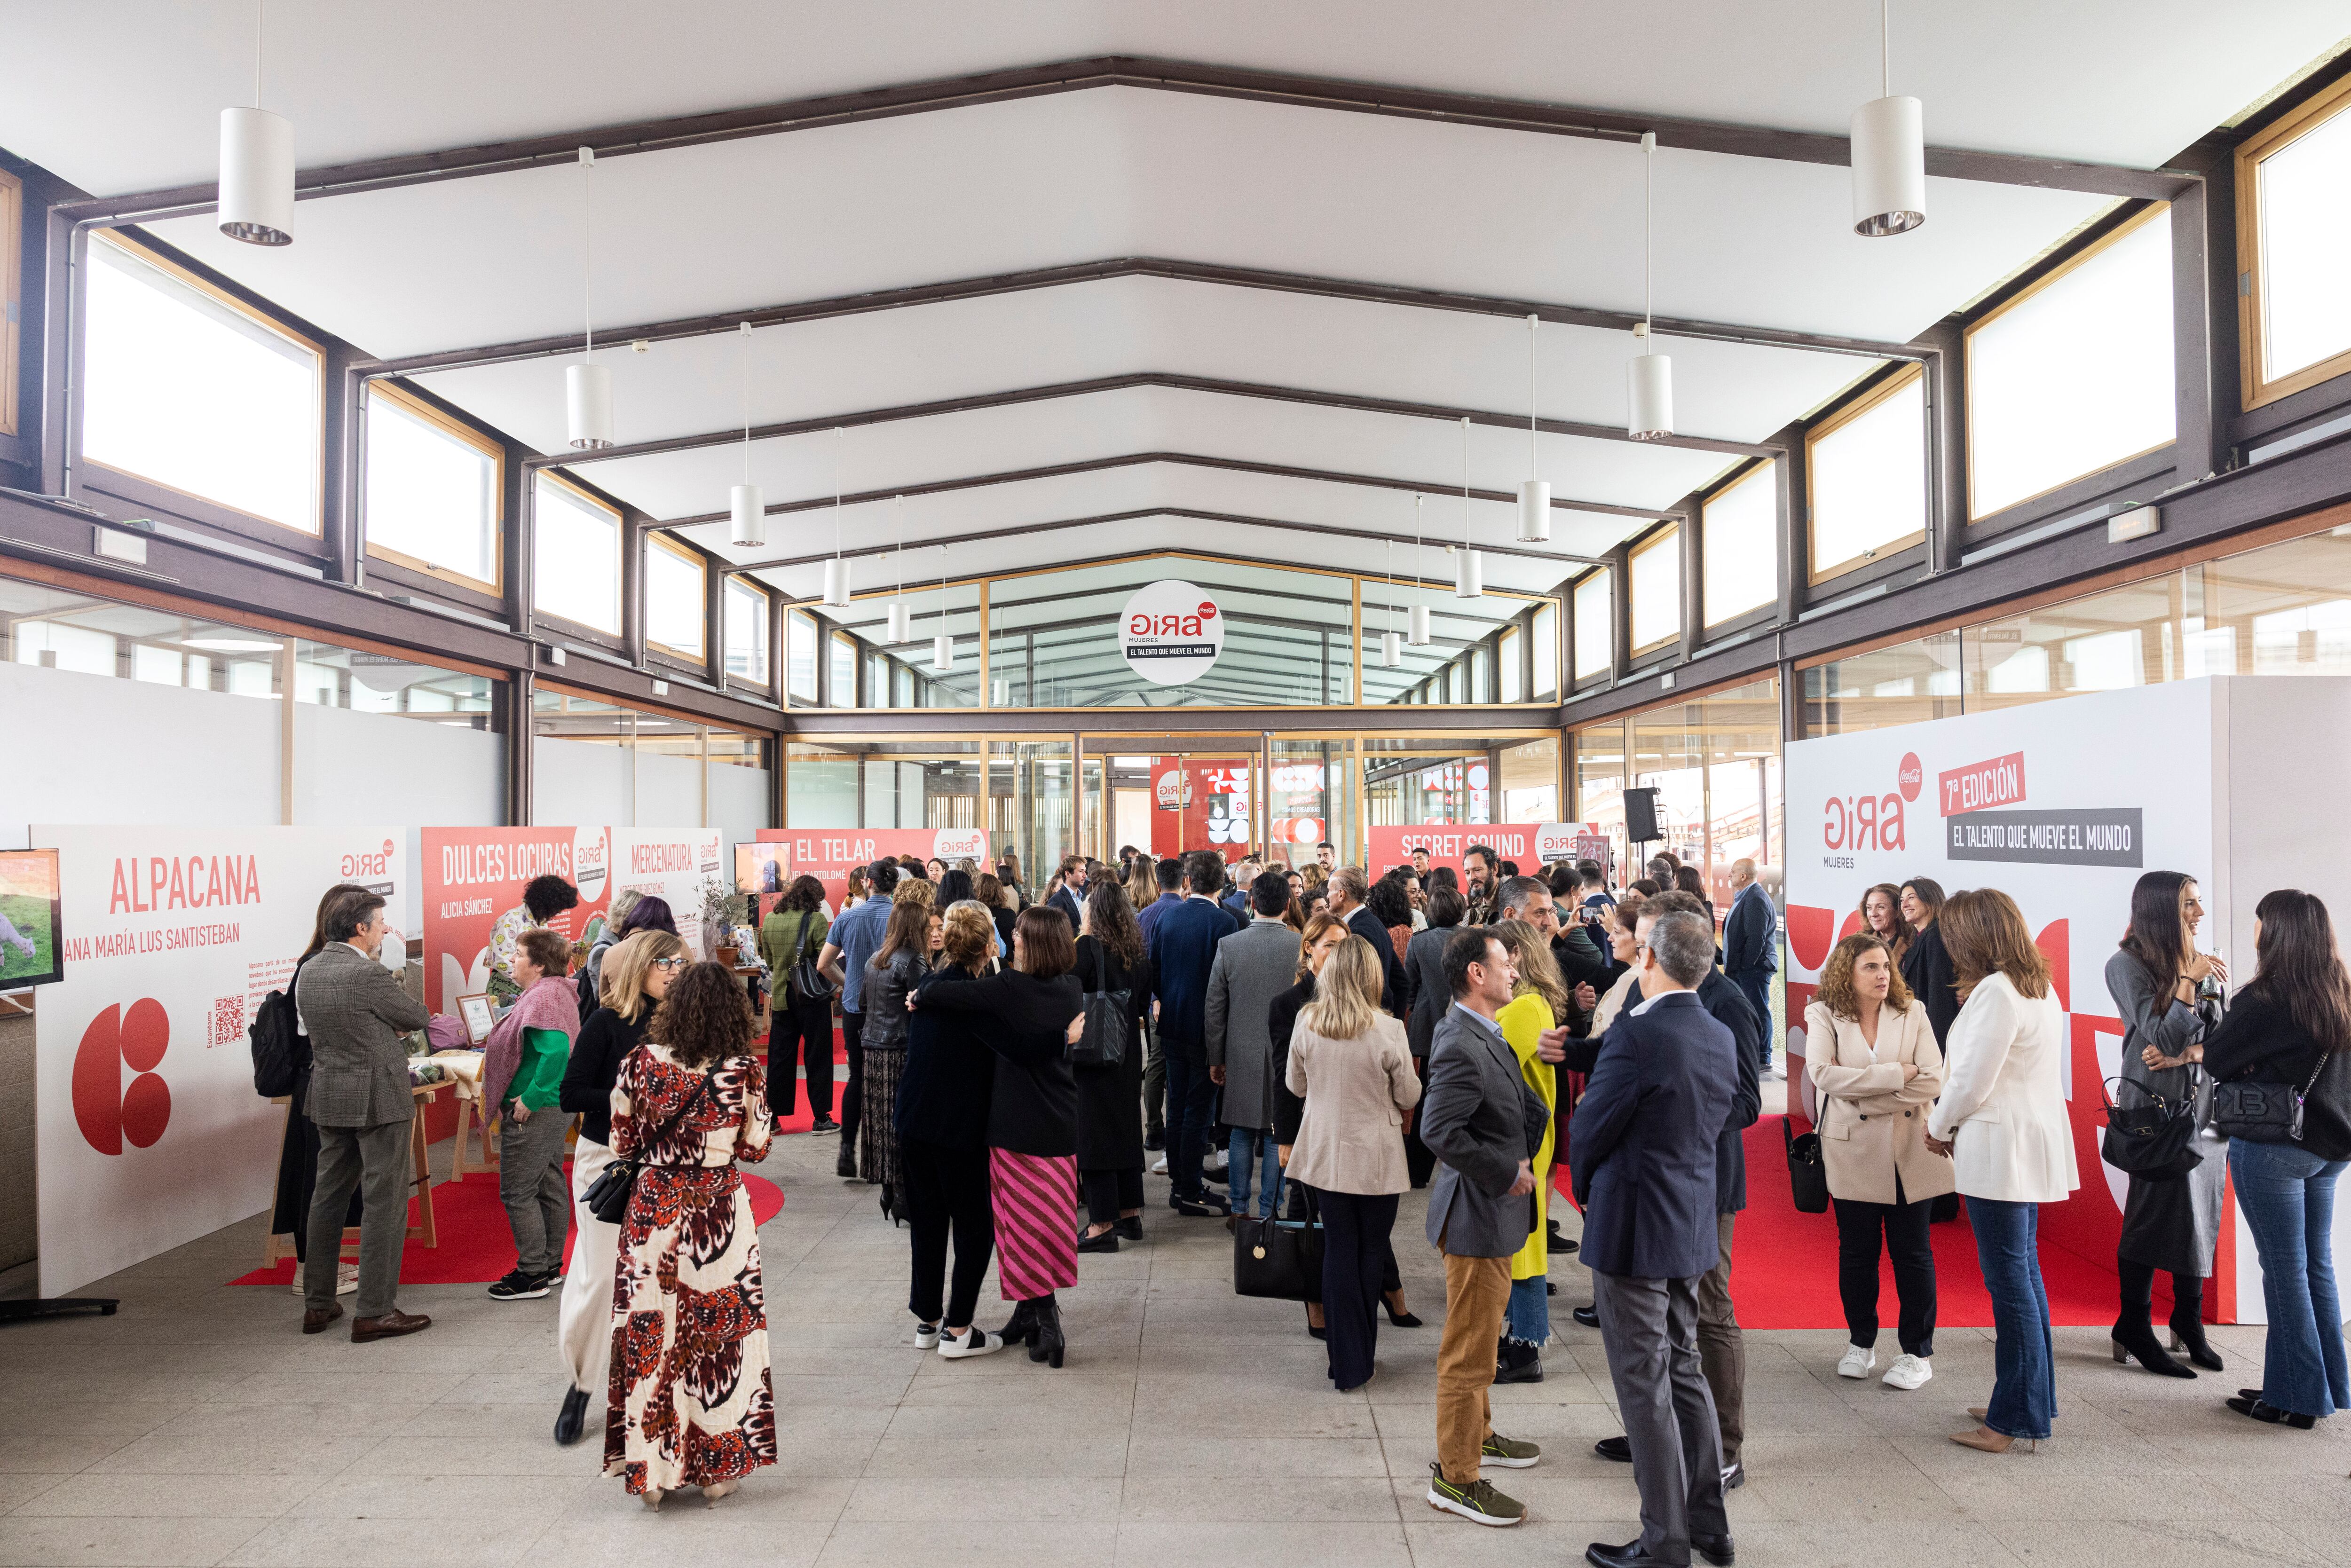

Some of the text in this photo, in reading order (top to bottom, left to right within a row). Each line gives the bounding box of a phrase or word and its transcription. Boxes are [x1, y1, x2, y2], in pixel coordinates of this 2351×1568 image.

[1900, 768, 1921, 784] Coca-Cola
[1962, 758, 2018, 808] EDICIÓN
[1402, 835, 1462, 857] SECRET
[1954, 824, 2131, 851] EL TALENTO QUE MUEVE EL MUNDO
[631, 844, 693, 874] MERCENATURA
[797, 839, 876, 862] EL TELAR
[443, 842, 569, 886] DULCES LOCURAS
[1823, 856, 1854, 869] MUJERES
[110, 854, 261, 914] ALPACANA
[653, 880, 664, 894] GÓMEZ
[441, 896, 493, 919] ALICIA SÁNCHEZ
[63, 922, 240, 962] ANA MARÍA LUS SANTISTEBAN
[249, 991, 263, 1000] proviene
